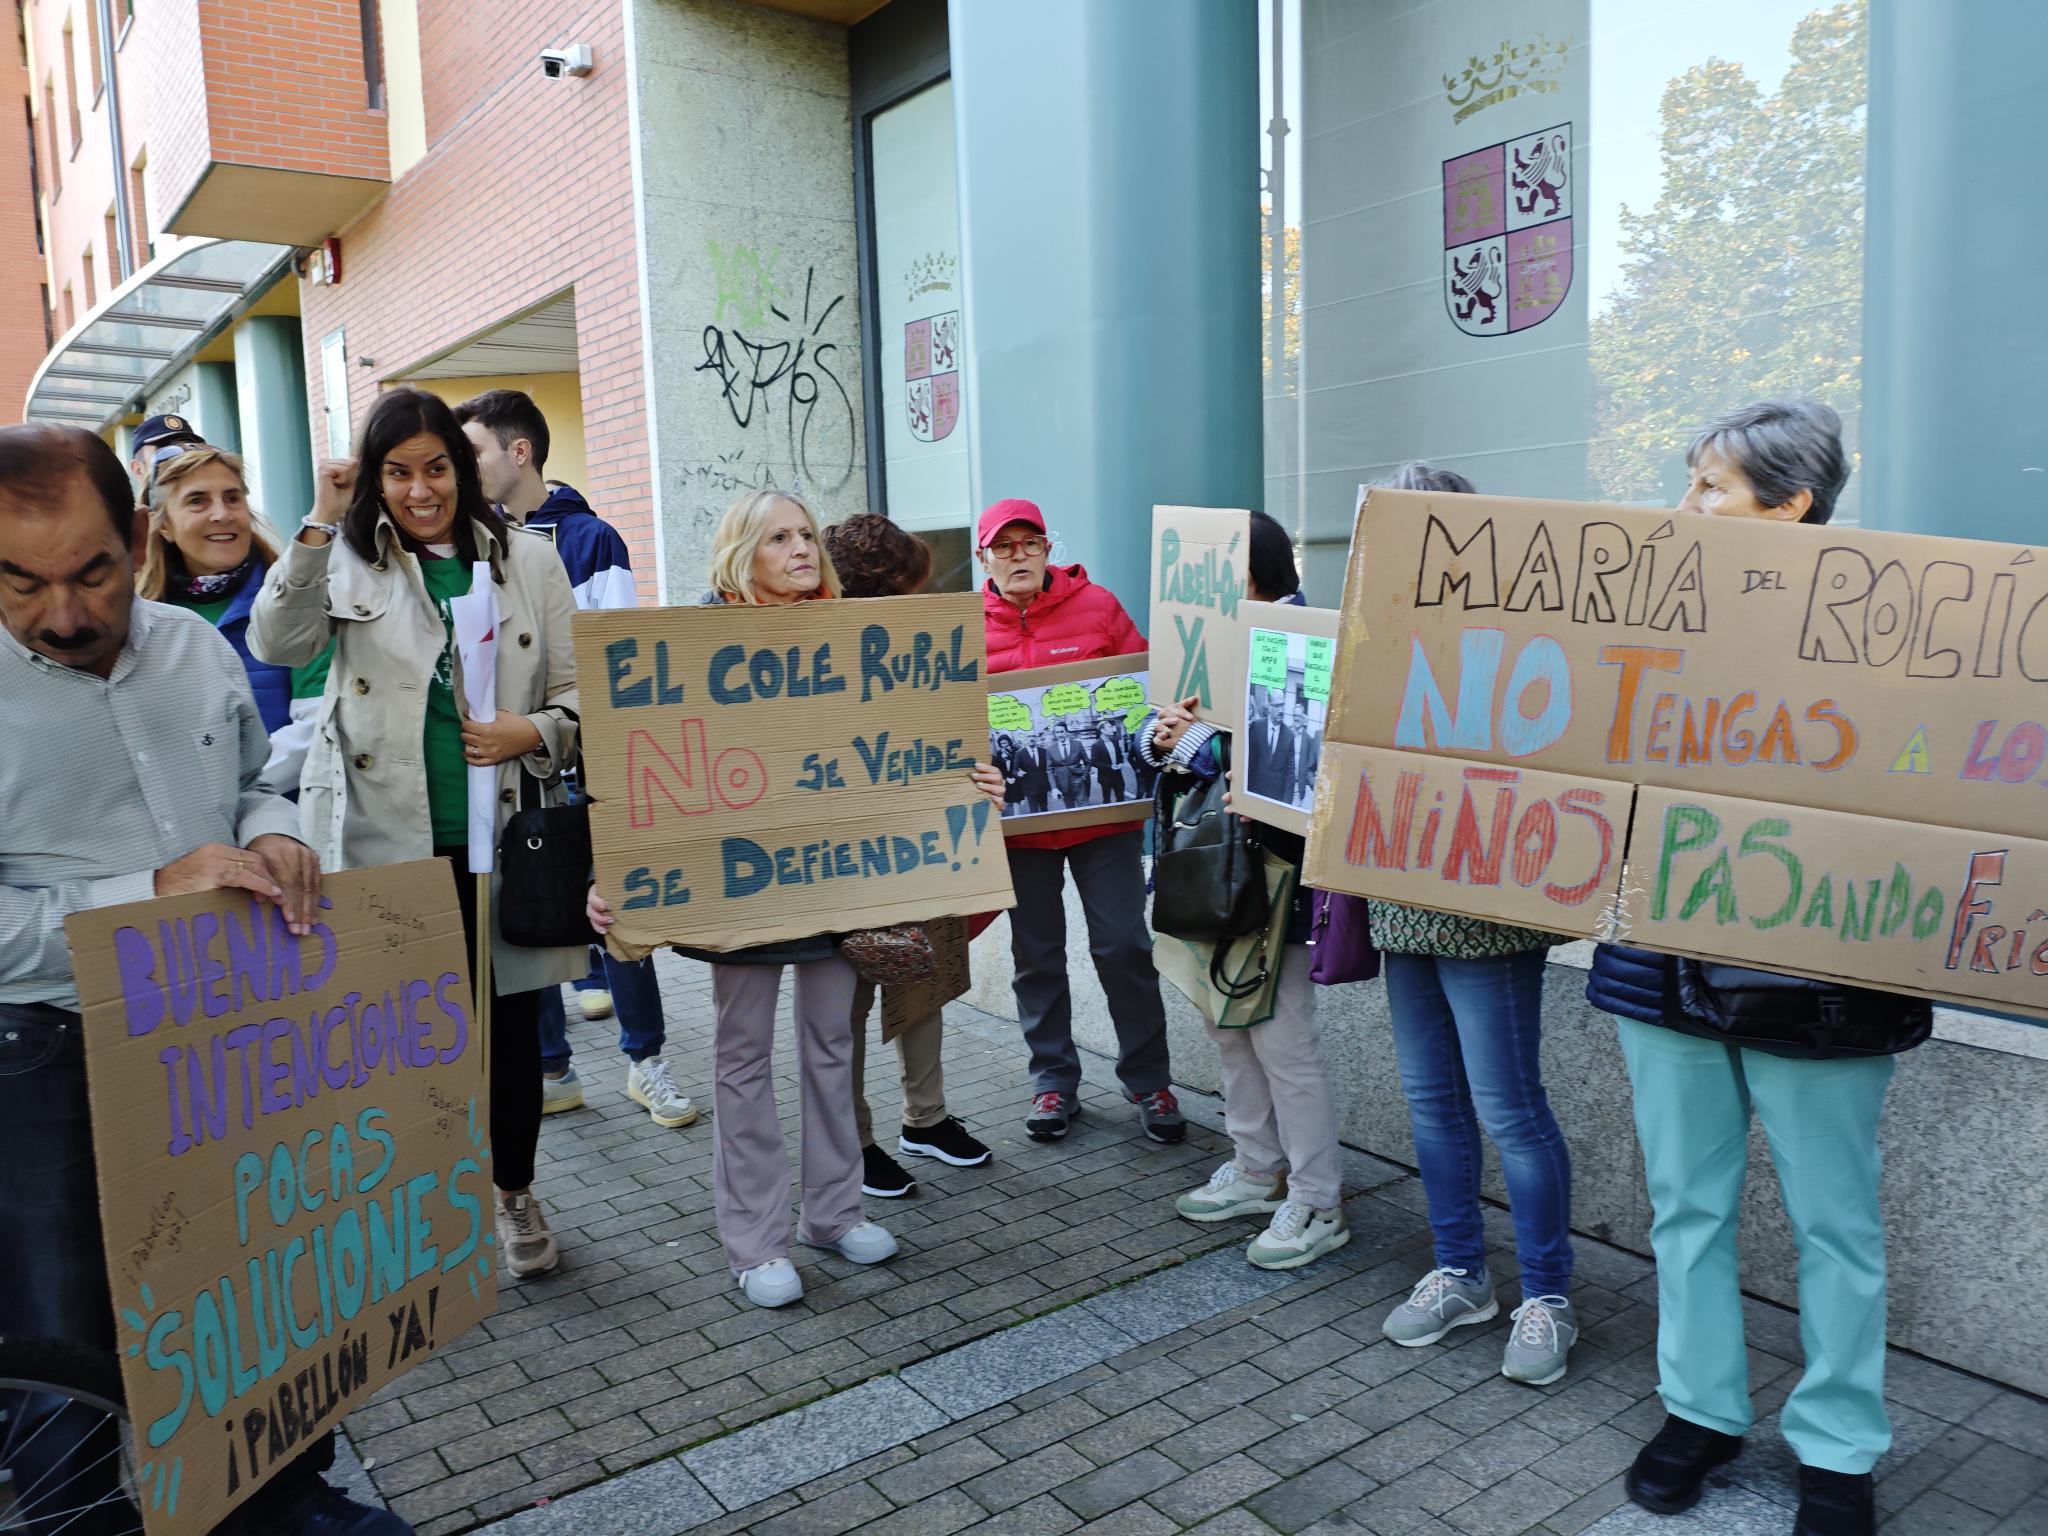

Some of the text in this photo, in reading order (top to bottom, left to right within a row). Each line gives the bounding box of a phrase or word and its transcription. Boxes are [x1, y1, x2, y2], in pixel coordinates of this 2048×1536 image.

[1414, 513, 1708, 633] MARÍA
[1741, 567, 1787, 595] DEL
[605, 623, 978, 708] EL COLE RURAL
[1173, 613, 1213, 711] YA
[1393, 626, 2048, 786] NO TENGAS A LO
[795, 753, 846, 791] SE
[851, 731, 977, 787] VENDE
[621, 867, 691, 911] SE
[114, 894, 338, 1037] BUENAS
[159, 972, 468, 1157] INTENCIONES
[234, 1106, 397, 1246] POCAS
[148, 1158, 483, 1448] SOLUCIONES
[225, 1286, 439, 1497] ¡PABELLÓN YA!
